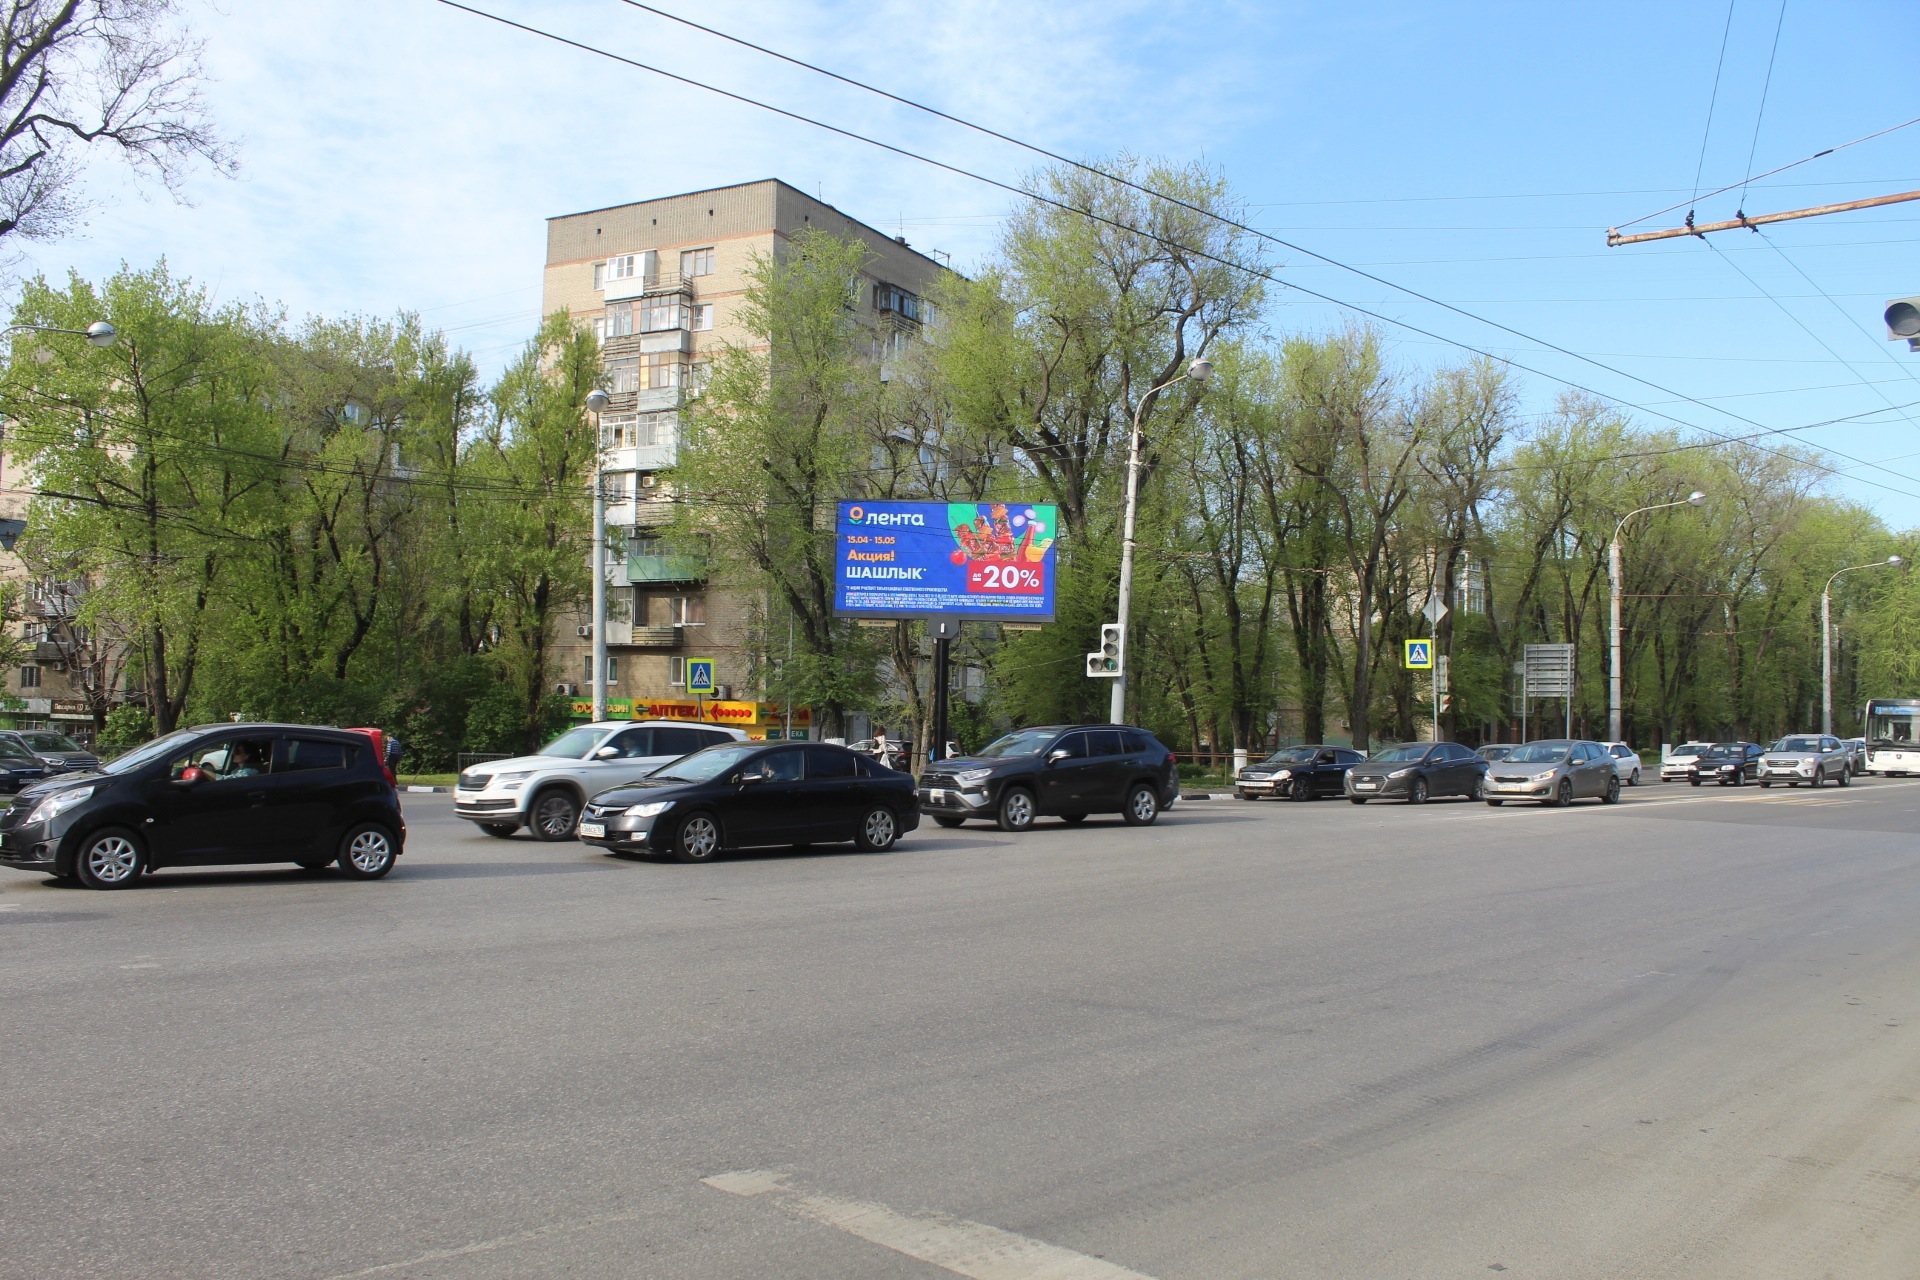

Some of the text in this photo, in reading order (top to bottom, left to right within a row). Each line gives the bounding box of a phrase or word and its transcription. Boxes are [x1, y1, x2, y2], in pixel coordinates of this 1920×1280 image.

[865, 513, 925, 526] лента
[847, 535, 869, 544] 15.04
[874, 536, 896, 545] 15.05
[847, 549, 895, 563] Акция!
[648, 704, 706, 719] АПТЕКА
